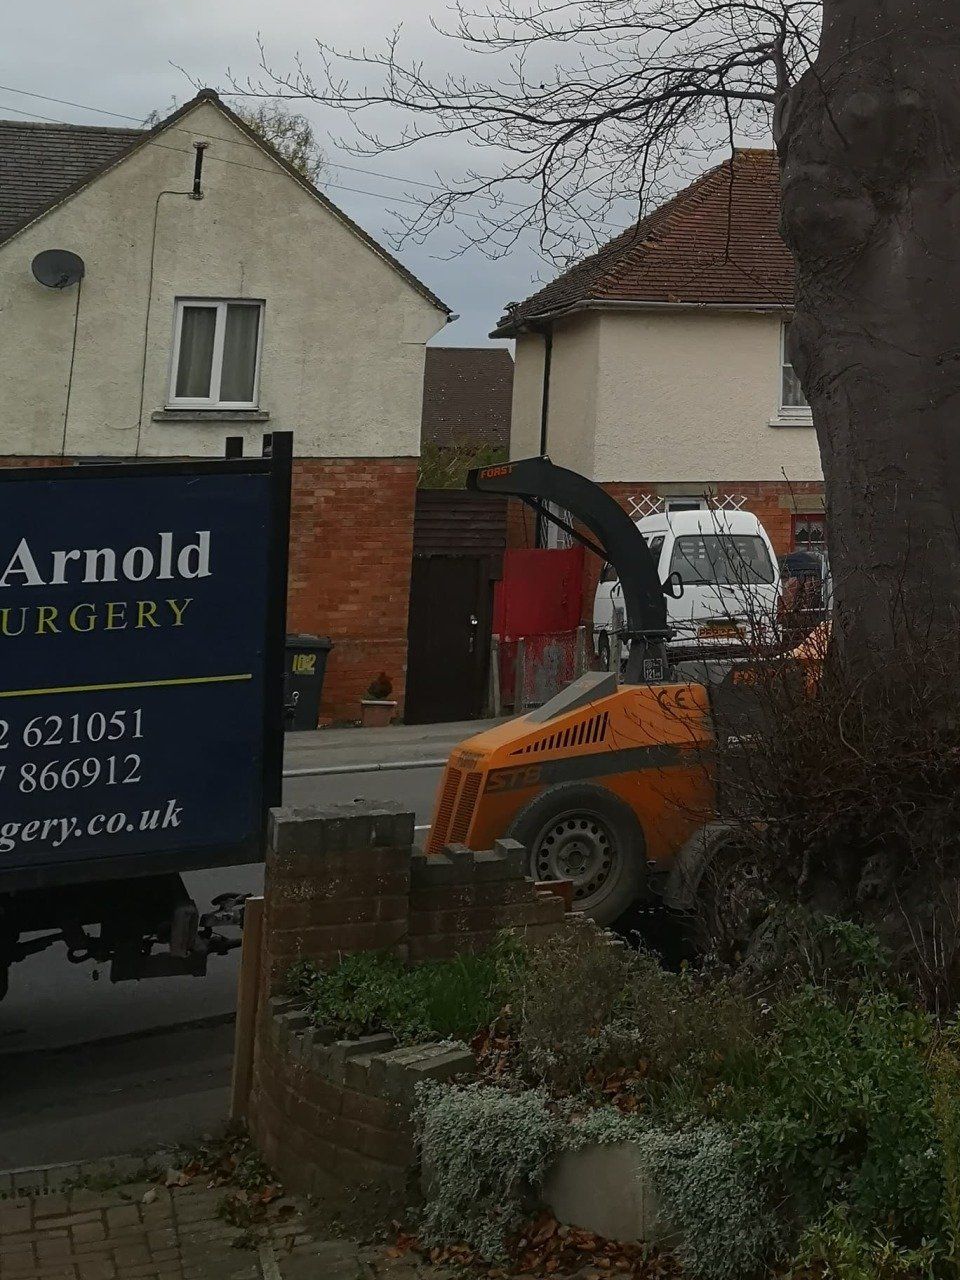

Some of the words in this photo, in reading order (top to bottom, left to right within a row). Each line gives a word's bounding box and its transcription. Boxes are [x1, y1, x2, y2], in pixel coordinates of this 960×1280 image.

[0, 530, 213, 587] Arnold
[23, 708, 144, 747] 621051
[19, 753, 142, 793] 866912
[0, 799, 183, 852] gery.co.uk
